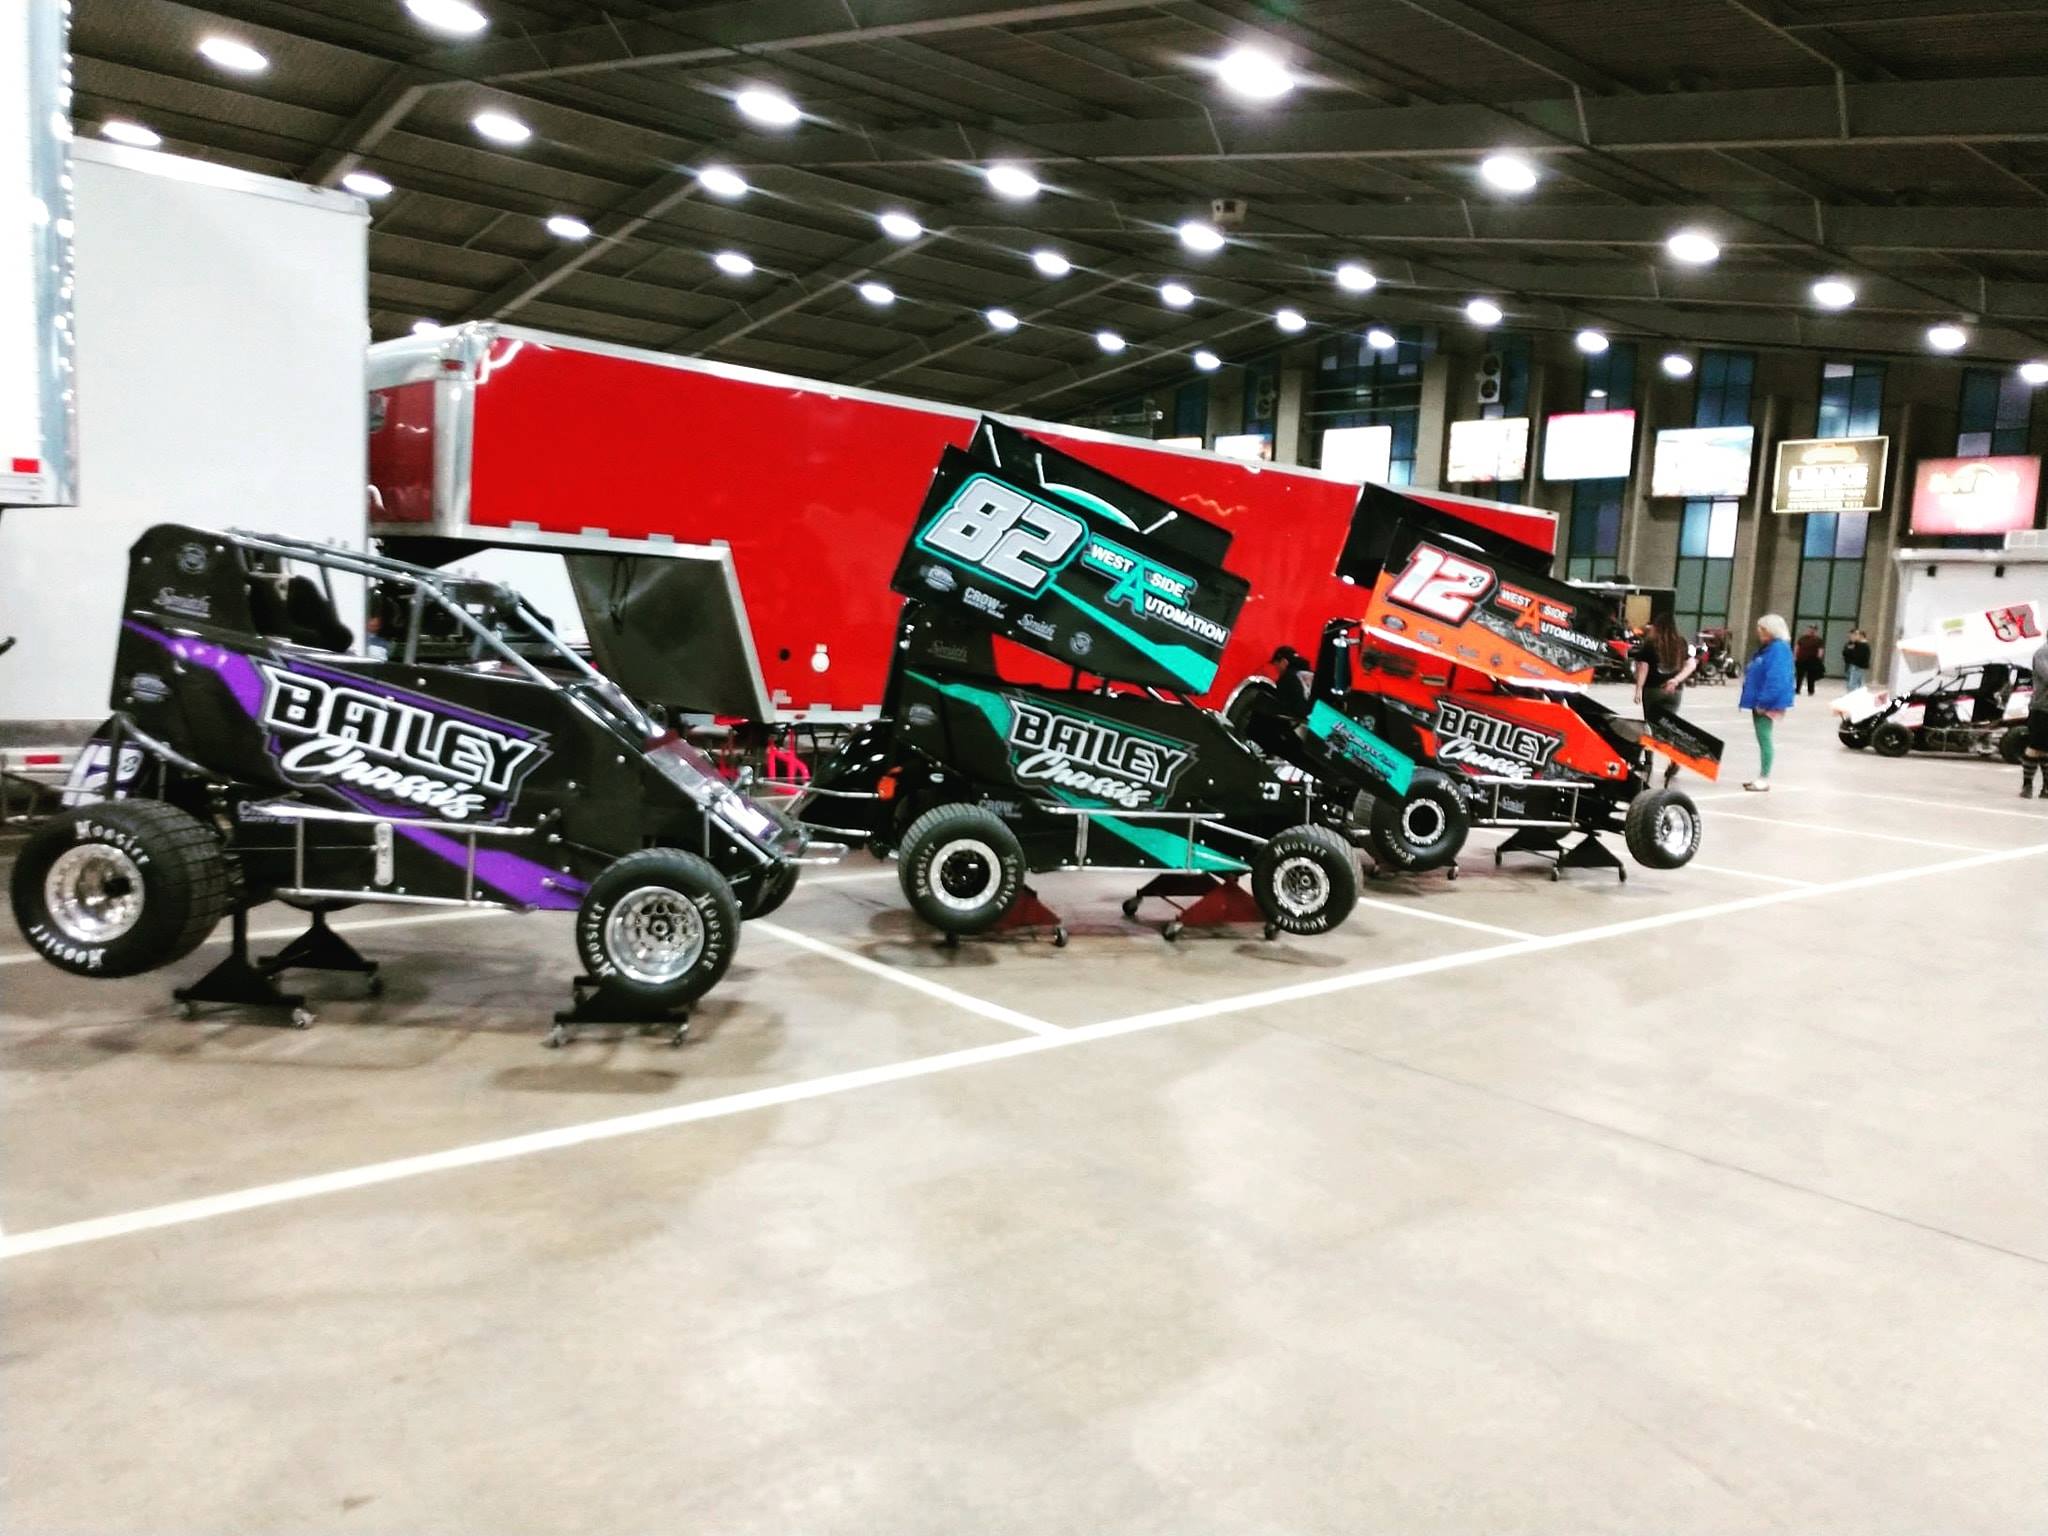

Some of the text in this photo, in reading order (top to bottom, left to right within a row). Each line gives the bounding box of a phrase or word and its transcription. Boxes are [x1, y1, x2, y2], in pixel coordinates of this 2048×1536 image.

[925, 478, 1083, 588] 82
[1090, 544, 1186, 598] WEST SIDE
[1390, 544, 1492, 624] 12
[1499, 590, 1568, 621] WEST SIDE
[261, 665, 537, 791] BAILEY
[1010, 700, 1188, 788] BAILEY
[1436, 700, 1560, 766] BAILEY
[280, 737, 487, 819] Chassis
[1016, 750, 1152, 808] Chassis
